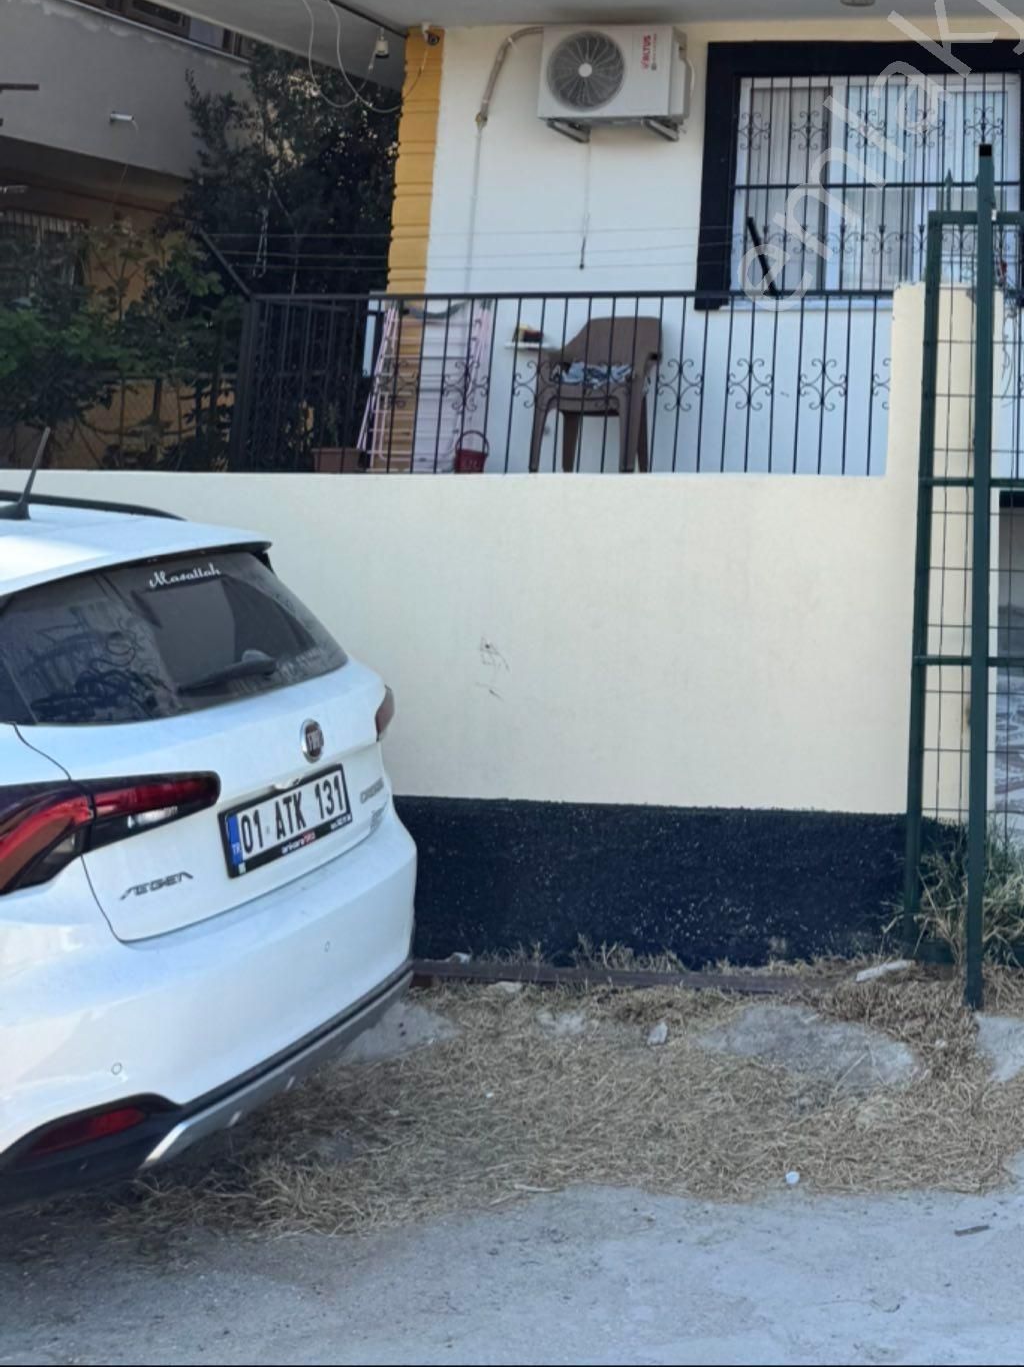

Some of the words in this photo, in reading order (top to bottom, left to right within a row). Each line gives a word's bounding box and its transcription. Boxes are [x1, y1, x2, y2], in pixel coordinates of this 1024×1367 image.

[241, 809, 264, 855] 01
[274, 790, 307, 840] ATK
[314, 774, 344, 820] 131
